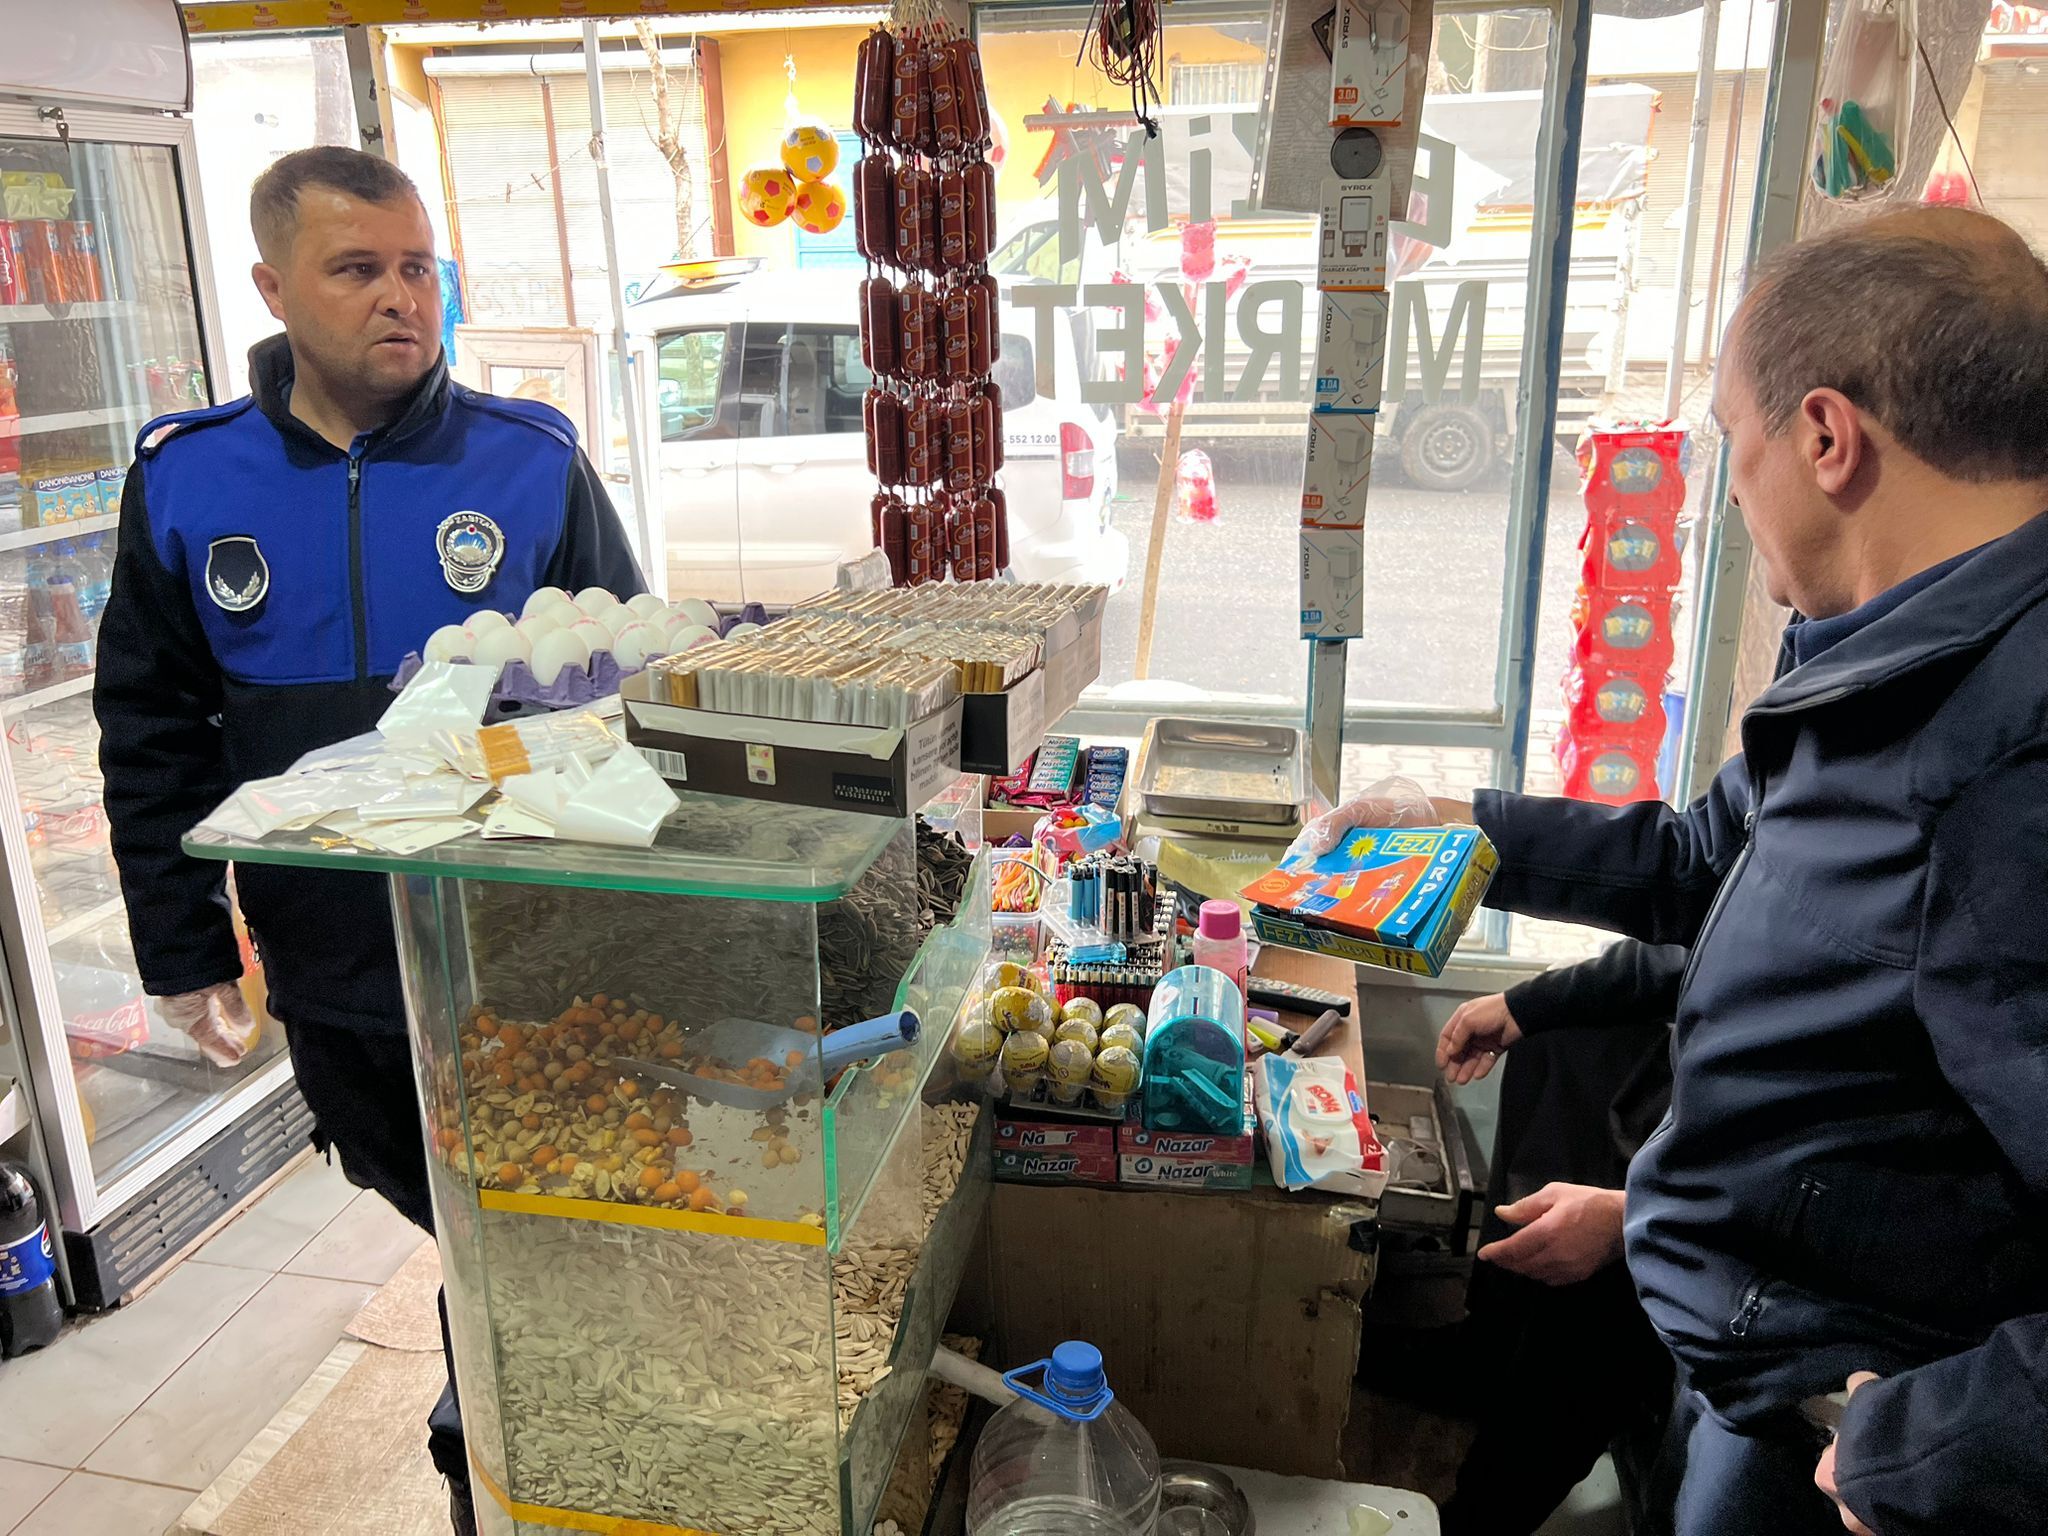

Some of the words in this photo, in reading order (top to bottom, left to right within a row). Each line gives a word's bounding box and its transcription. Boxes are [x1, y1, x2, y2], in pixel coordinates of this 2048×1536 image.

[1341, 7, 1352, 49] SYROX
[1337, 88, 1357, 100] 3.0A
[1340, 184, 1373, 192] SYROX
[1324, 305, 1333, 343] SYROX
[1320, 379, 1338, 389] 3.0A
[1009, 435, 1028, 444] 552
[1030, 435, 1042, 444] 12
[1044, 434, 1057, 443] 00
[1308, 426, 1318, 462] SYROX
[66, 471, 95, 487] ANONE
[1303, 496, 1322, 505] 3.0A
[1303, 611, 1321, 620] 3.0A
[1387, 836, 1435, 853] FEZA
[1262, 922, 1312, 947] FEZA
[1020, 1130, 1077, 1147] Nar
[1155, 1137, 1215, 1154] Nazar
[1022, 1158, 1080, 1176] Nazar
[1158, 1163, 1216, 1182] Nazar
[1213, 1169, 1238, 1178] White
